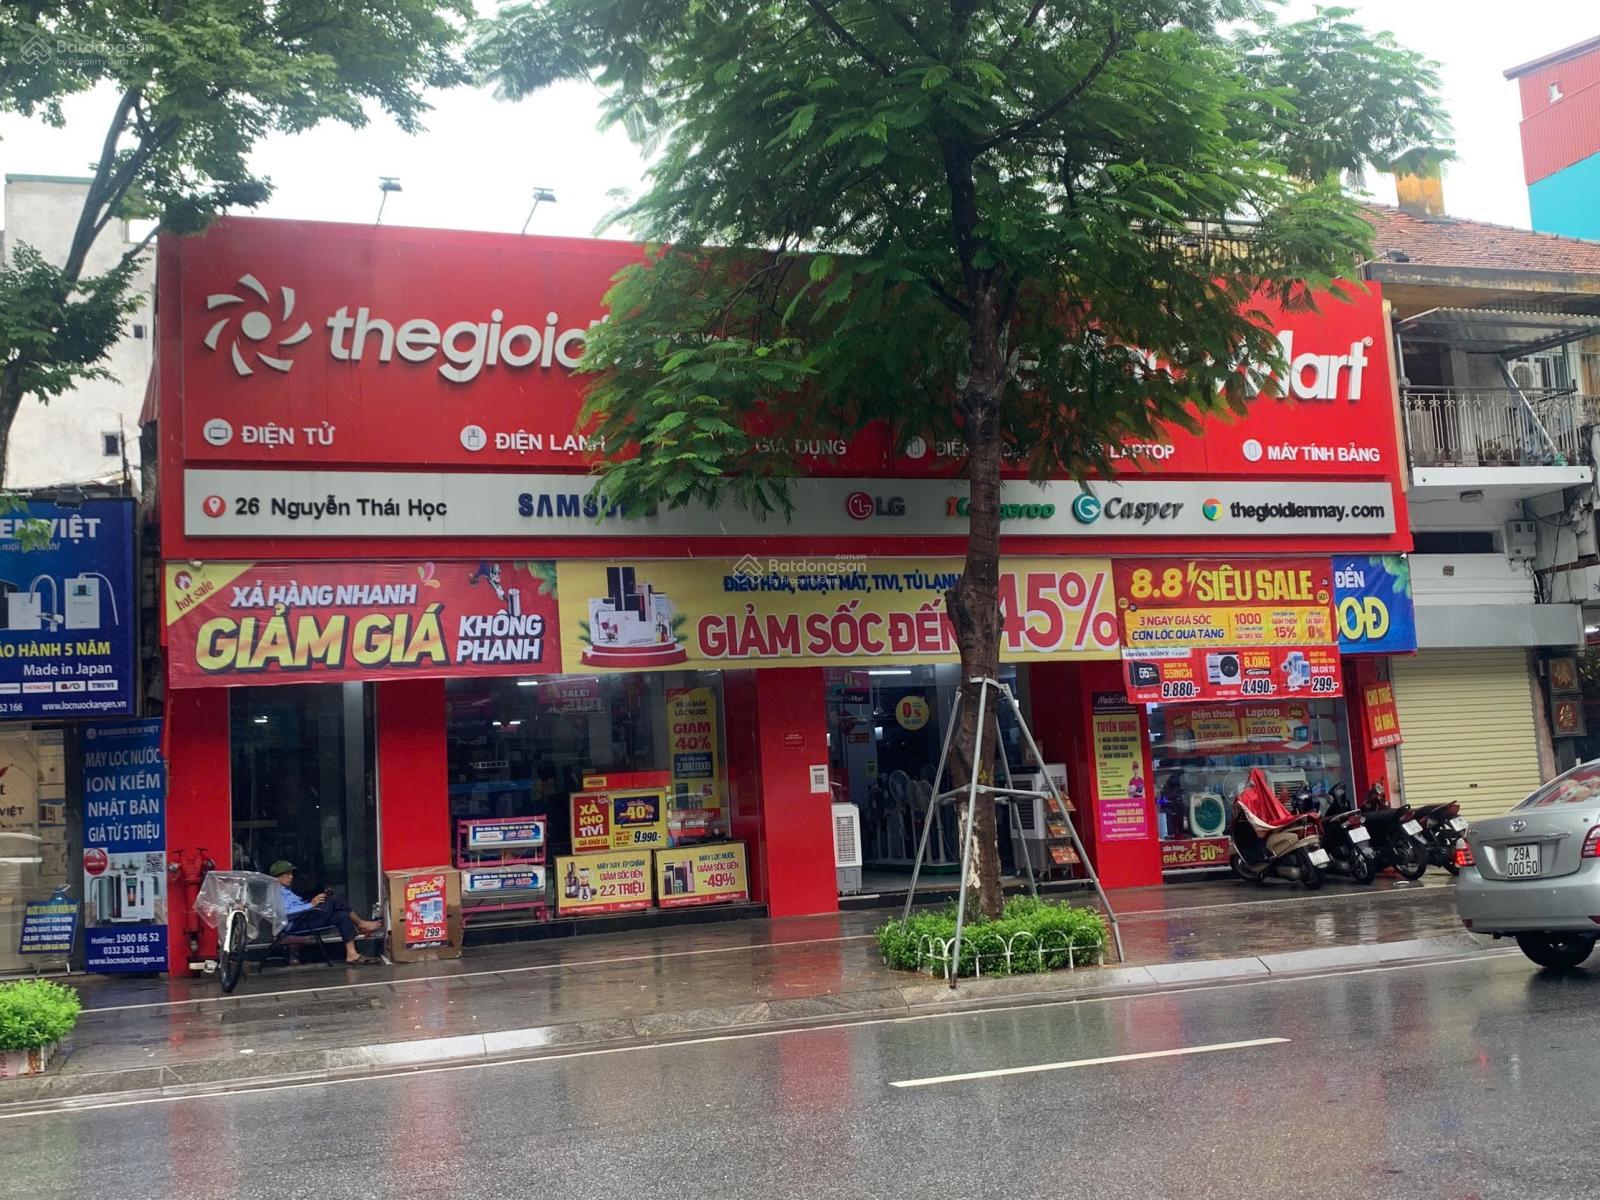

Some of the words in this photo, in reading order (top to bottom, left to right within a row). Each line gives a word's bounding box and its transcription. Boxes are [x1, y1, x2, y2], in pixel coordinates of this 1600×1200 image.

[241, 421, 295, 449] ĐIỆN
[302, 420, 336, 446] TỬ
[494, 429, 543, 455] ĐIỆN
[795, 439, 848, 460] DỤNG
[1110, 444, 1175, 460] LAPTOP
[1266, 442, 1300, 461] MÁY
[1300, 442, 1335, 462] TÍNH
[1337, 441, 1381, 463] BẢNG
[235, 497, 261, 516] 26
[271, 494, 351, 520] Nguyễn
[356, 497, 401, 517] Thái
[407, 498, 448, 522] Học
[875, 496, 906, 517] LG
[1104, 497, 1184, 526] Casper
[798, 573, 837, 595] QUẠT
[904, 568, 923, 590] TỦ
[1130, 567, 1184, 599] 8.8
[1196, 563, 1253, 602] SIÊU
[1255, 569, 1314, 602] SALE
[1335, 562, 1365, 589] ĐẾN
[175, 592, 194, 612] hot
[193, 579, 214, 600] sale
[230, 579, 265, 609] XẢ
[268, 581, 333, 609] HÀNG
[335, 584, 417, 606] NHANH
[458, 608, 543, 638] KHÔNG
[697, 603, 800, 657] GIẢM
[806, 599, 884, 655] SỐC
[1140, 615, 1146, 625] 3
[1234, 613, 1262, 625] 1000
[195, 602, 346, 670] GIẢM
[351, 603, 449, 668] GIÁ
[1274, 626, 1297, 639] 15%
[18, 641, 62, 658] HÀNH
[64, 643, 73, 656] 5
[76, 638, 111, 656] NĂM
[456, 639, 541, 662] PHANH
[23, 663, 59, 676] Made
[61, 663, 73, 675] in
[75, 663, 113, 677] Japan
[1162, 681, 1200, 697] 9.880.-
[1242, 679, 1276, 694] 4.490.-
[1312, 677, 1338, 691] 299.-
[42, 701, 127, 711] www.locnuockangen.vn
[1245, 707, 1280, 719] Laptop
[675, 736, 711, 750] 40%
[86, 776, 116, 793] ION
[88, 797, 126, 820] NHẬT
[129, 794, 160, 816] BẢN
[579, 814, 604, 826] KHO
[123, 826, 130, 841] 5
[131, 820, 160, 844] TRIỆU
[633, 830, 662, 844] 9.990.-
[1200, 844, 1224, 860] 50%
[1513, 846, 1531, 861] 29A
[1507, 860, 1539, 876] 000.50
[600, 884, 616, 897] 2.2
[617, 879, 646, 898] TRIỆU
[702, 872, 736, 888] -49%
[116, 933, 136, 943] 1900
[137, 932, 148, 942] 86
[149, 932, 160, 942] 52
[103, 946, 121, 955] 0332
